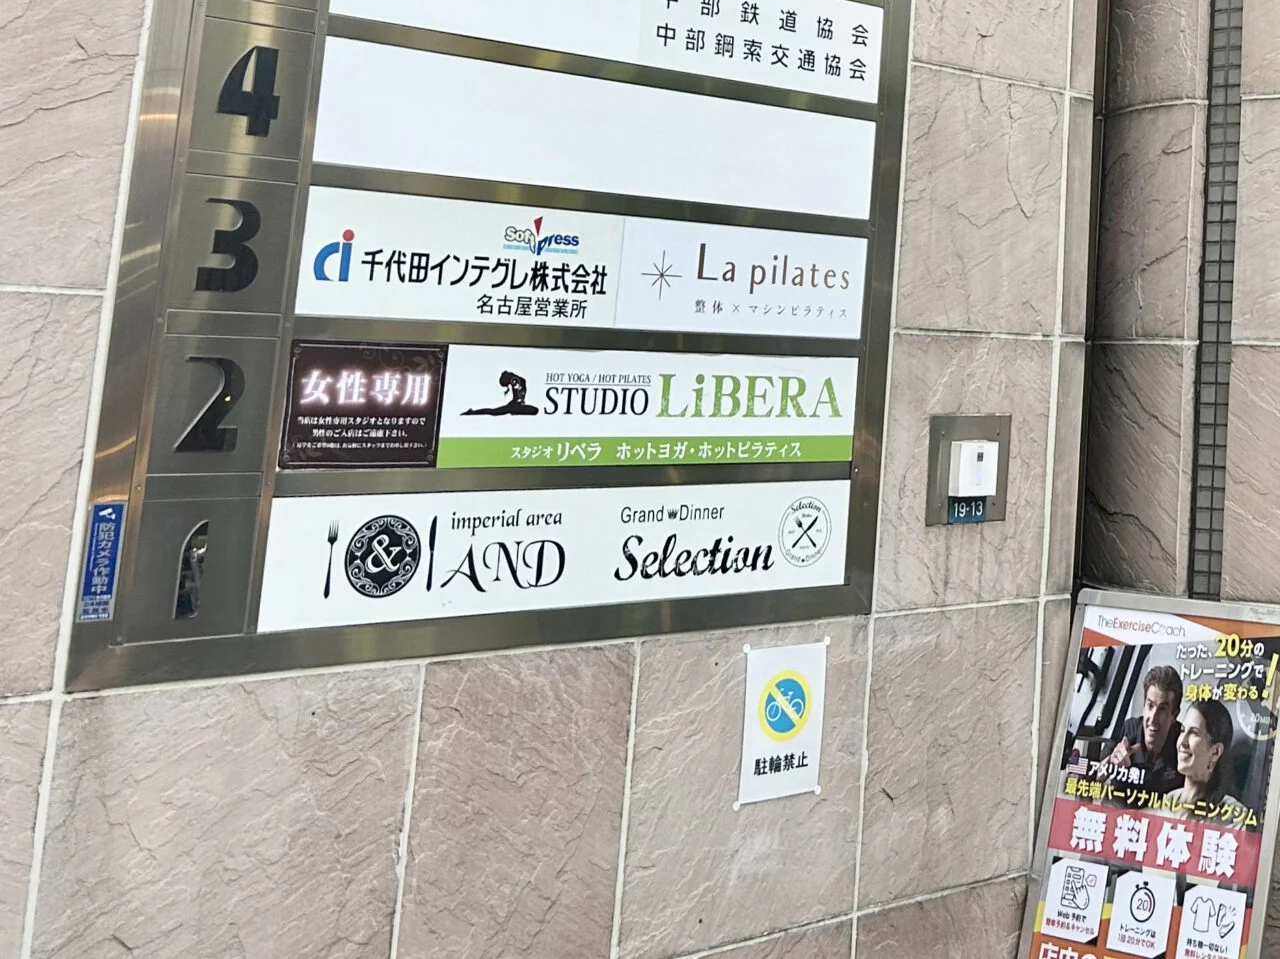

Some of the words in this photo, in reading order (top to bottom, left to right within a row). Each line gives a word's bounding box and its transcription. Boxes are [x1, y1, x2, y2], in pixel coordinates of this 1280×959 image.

[656, 22, 867, 81] 中部鋼索交通協会
[217, 46, 280, 137] 4
[194, 198, 261, 293] 3
[697, 243, 736, 282] La
[749, 254, 851, 294] pilates
[361, 247, 609, 296] 千代田インテグレ株式会社
[476, 293, 589, 320] 名古屋営業所
[299, 368, 432, 407] 女性専用
[543, 386, 650, 417] STUDIO
[655, 373, 844, 418] LiBERA
[546, 372, 566, 384] HOT
[567, 373, 591, 384] YOGA
[598, 373, 618, 384] HOT
[618, 374, 652, 385] PILATES
[173, 356, 246, 453] 2
[451, 508, 522, 537] imperial
[526, 511, 563, 527] area
[620, 505, 665, 524] Grand
[680, 505, 725, 523] Dinner
[790, 501, 822, 513] Selection
[91, 522, 116, 594] 防犯カメラ作動中
[172, 520, 209, 620] 1
[440, 539, 566, 593] AND
[613, 533, 777, 581] Selection
[1175, 633, 1265, 659] たった、20分の
[1179, 660, 1265, 681] トレーニングで
[753, 751, 808, 776] 駐輪禁止
[1064, 778, 1258, 827] 最先端パーソナルトレーニングジム
[1069, 805, 1239, 878] 無料体験
[1057, 909, 1070, 920] Web
[1136, 898, 1149, 912] 20
